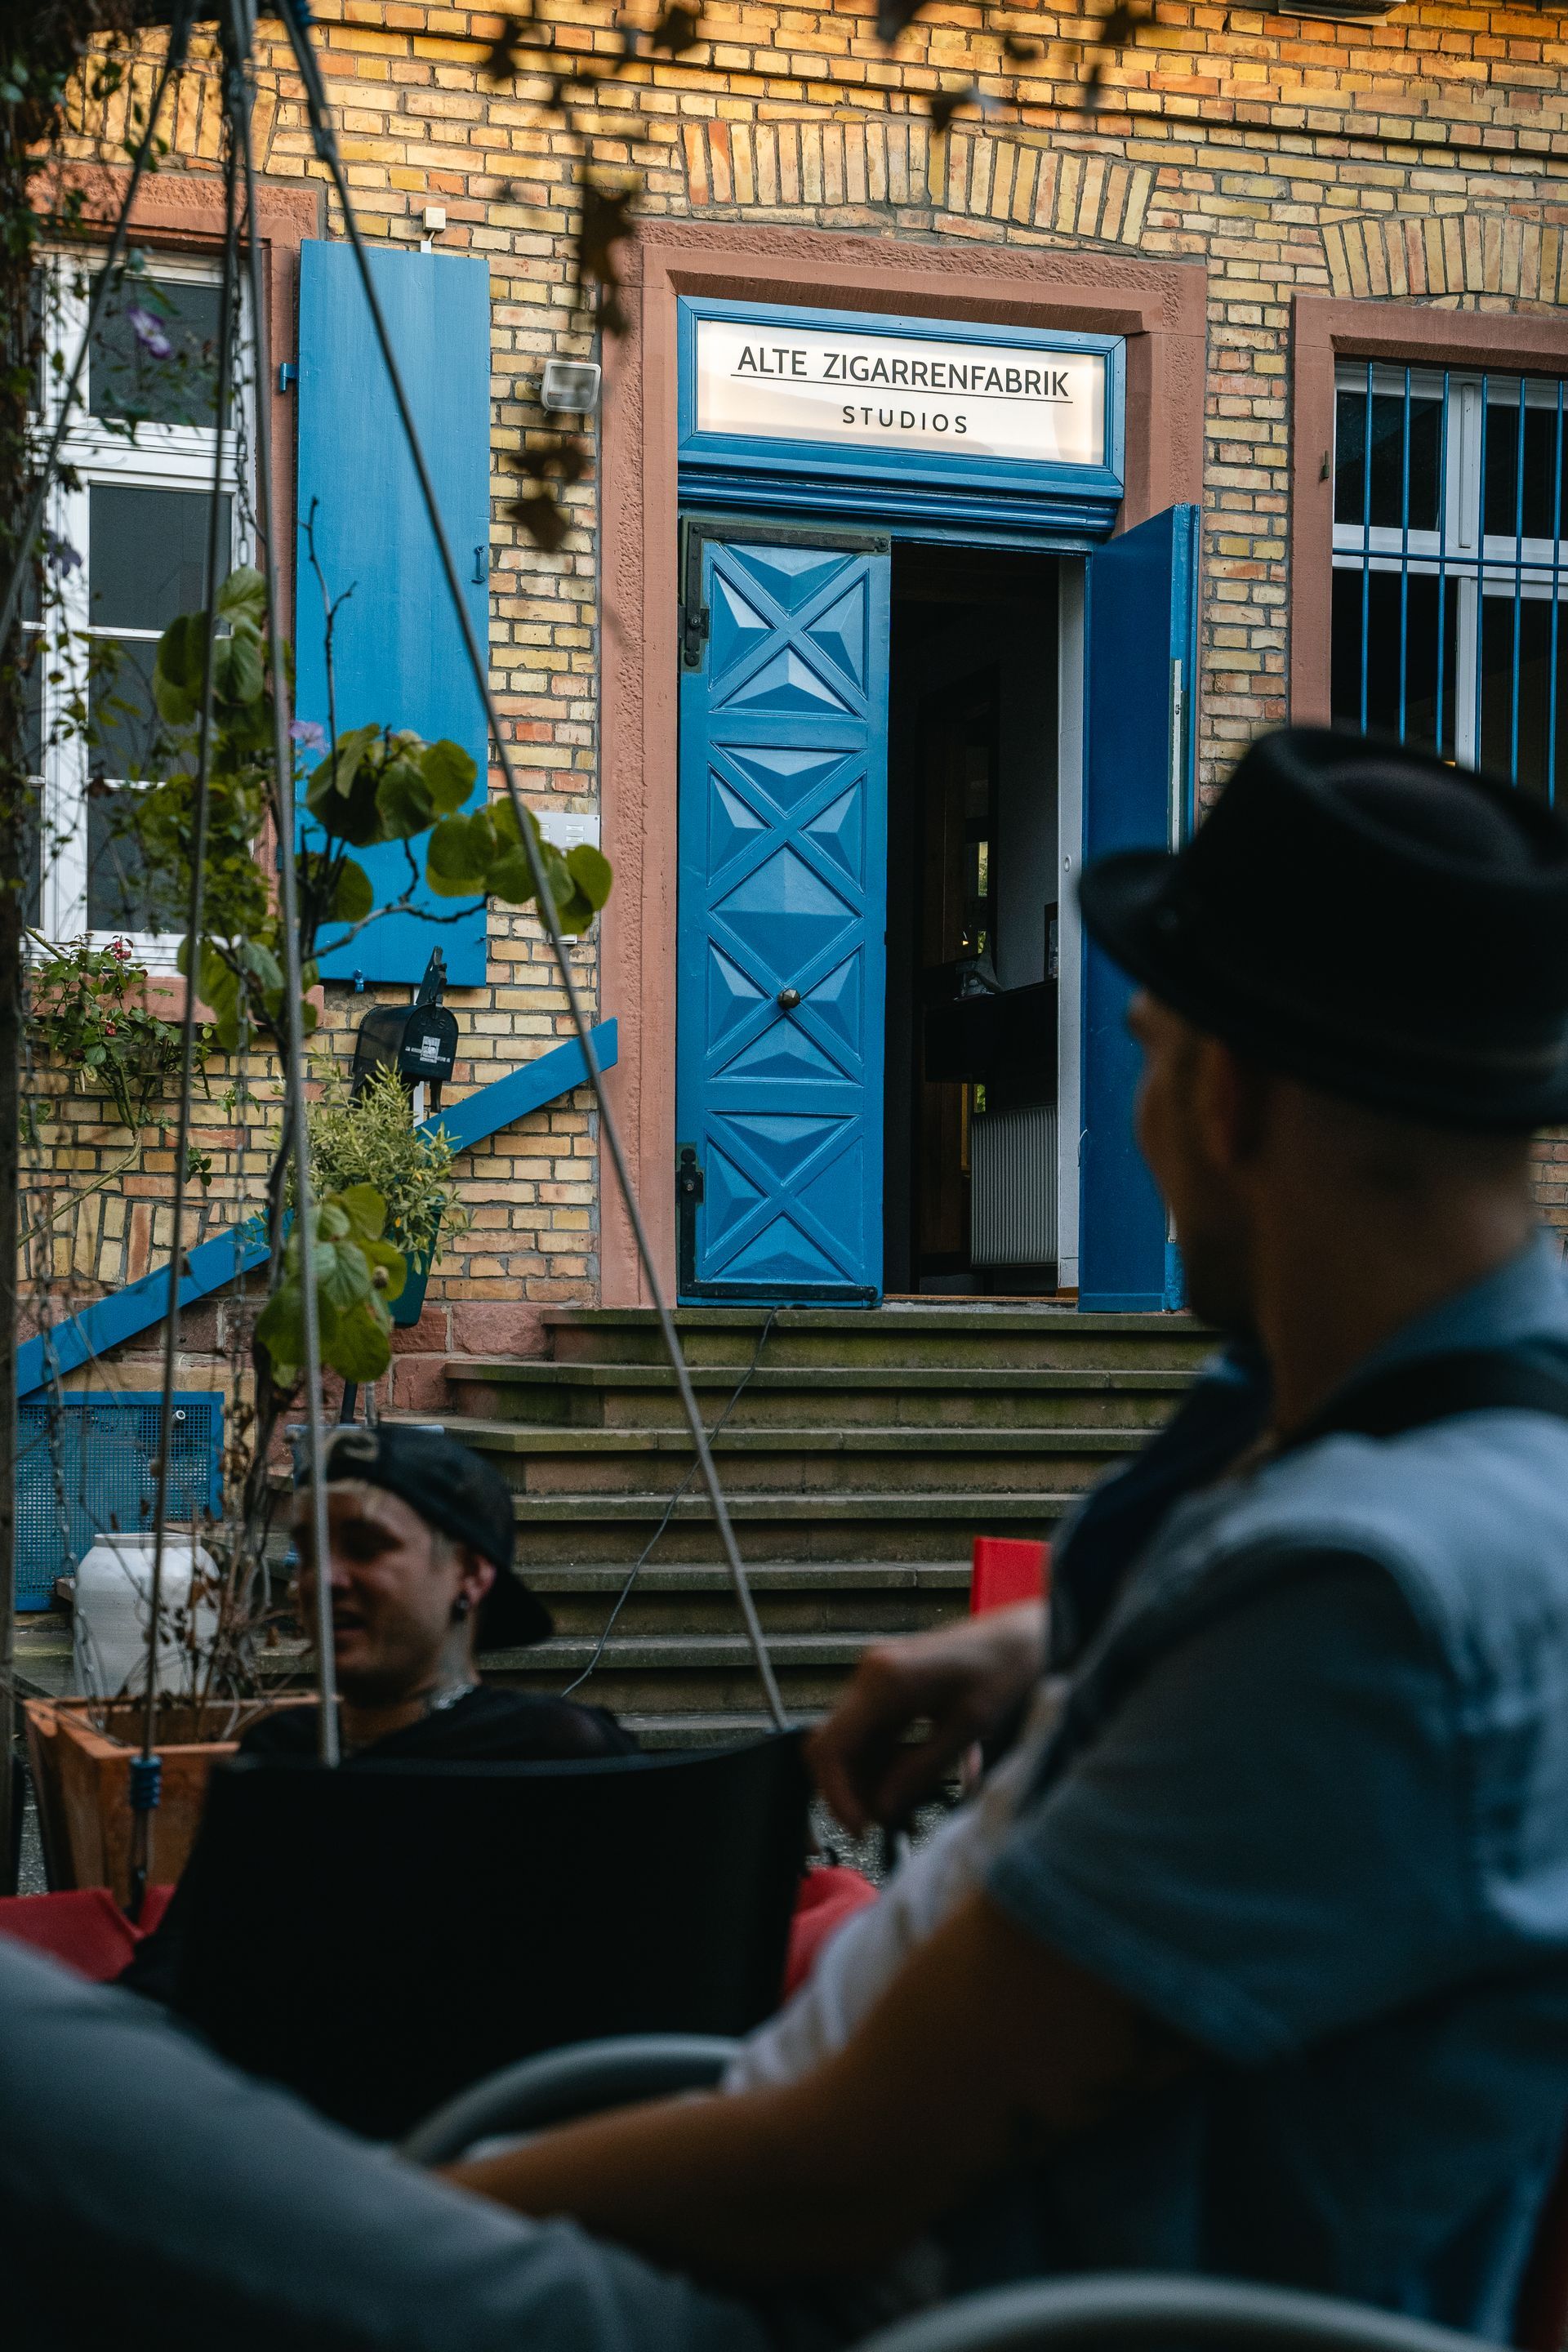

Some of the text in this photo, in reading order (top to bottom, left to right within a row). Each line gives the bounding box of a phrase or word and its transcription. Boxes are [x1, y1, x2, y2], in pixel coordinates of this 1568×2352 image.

[737, 345, 1069, 397] ALTE ZIGARRENFABRIK
[842, 405, 967, 434] STUDIOS
